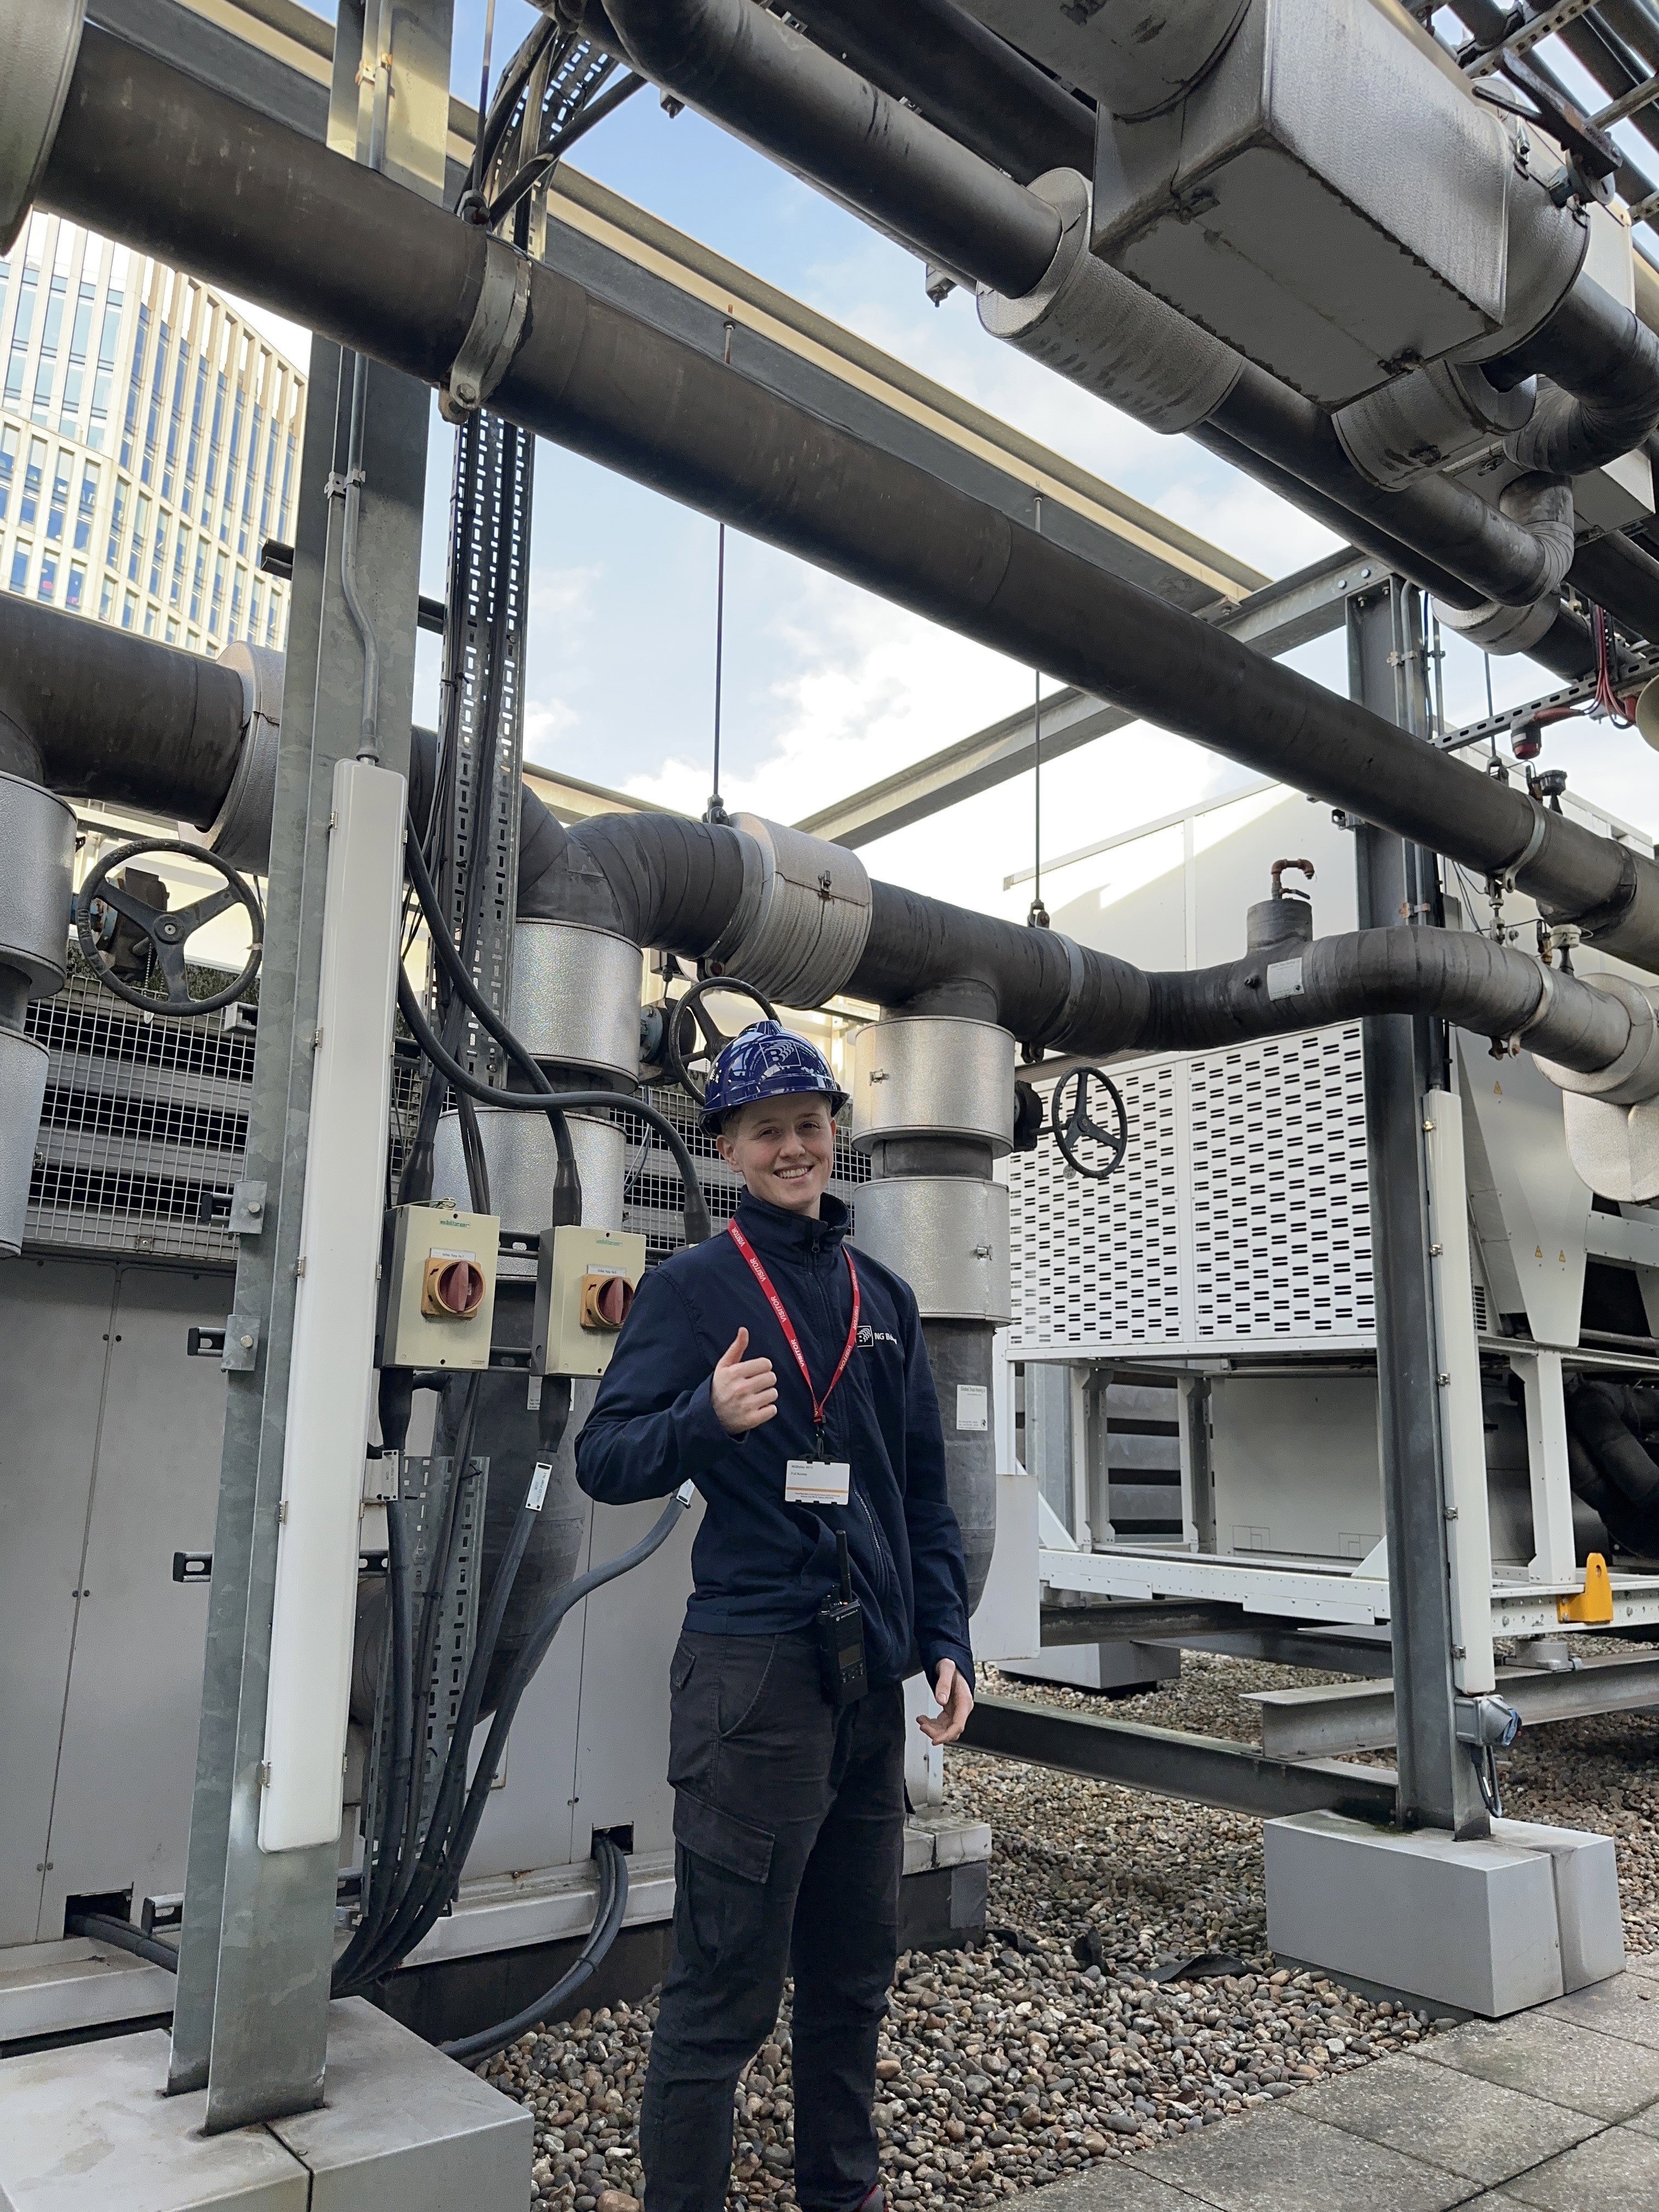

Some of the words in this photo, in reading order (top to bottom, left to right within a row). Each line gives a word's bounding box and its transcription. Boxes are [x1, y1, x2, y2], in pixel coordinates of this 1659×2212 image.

[731, 1227, 746, 1246] VISITOR
[750, 1257, 766, 1282] VISITOR
[770, 1295, 787, 1323] VISITOR
[791, 1339, 805, 1367] VISITOR
[839, 1345, 853, 1371] VISITOR
